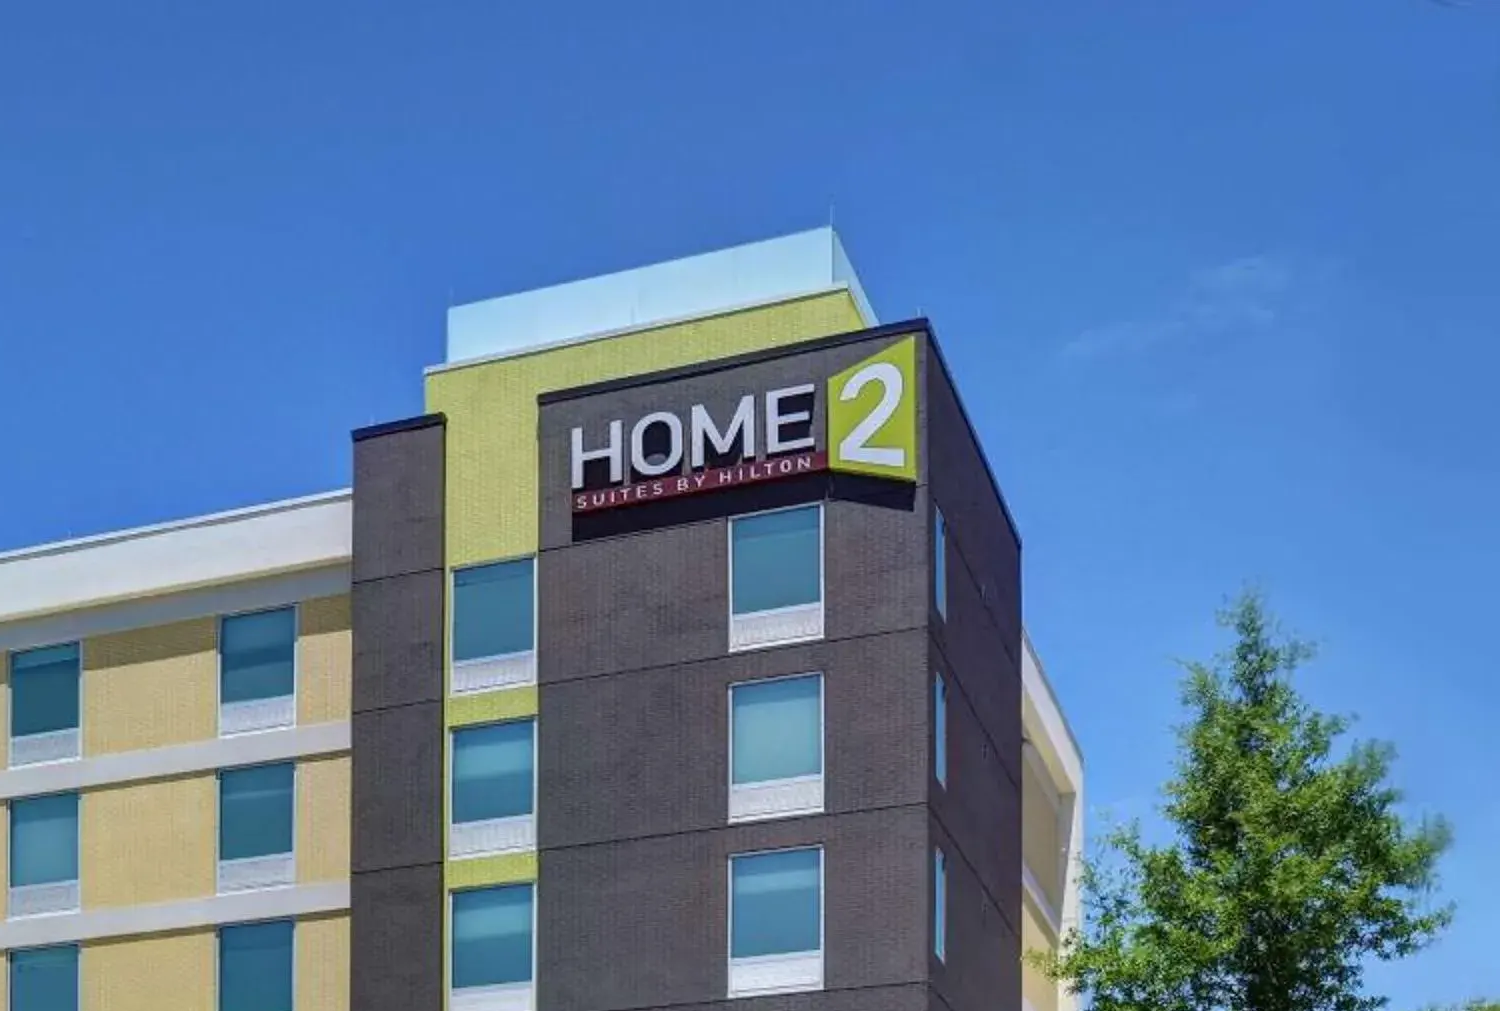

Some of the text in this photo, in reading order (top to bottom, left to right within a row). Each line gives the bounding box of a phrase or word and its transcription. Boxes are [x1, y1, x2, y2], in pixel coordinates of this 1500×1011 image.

[571, 362, 905, 489] HOME 2
[576, 456, 812, 509] SUITES BY HILTON
